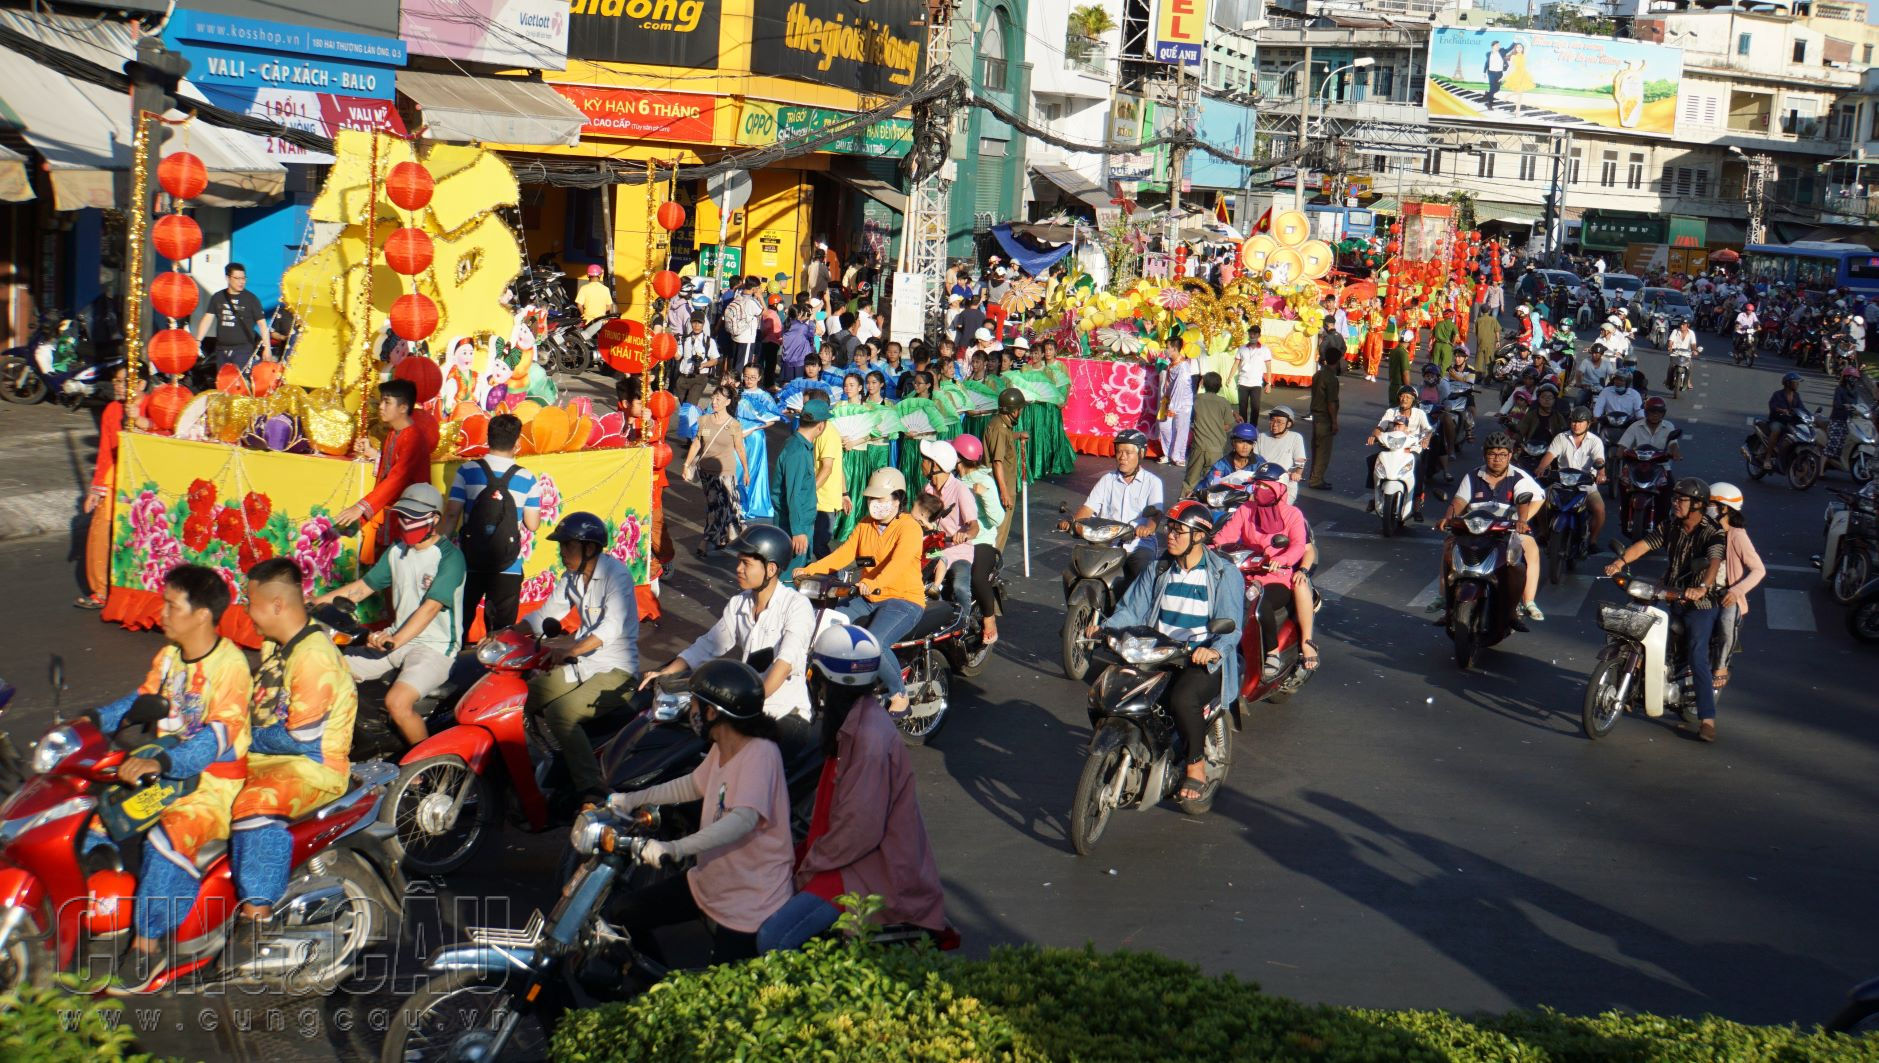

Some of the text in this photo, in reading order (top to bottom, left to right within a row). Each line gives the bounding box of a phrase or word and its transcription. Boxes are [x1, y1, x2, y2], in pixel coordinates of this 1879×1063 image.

[519, 12, 550, 29] Vietlott
[639, 22, 672, 31] .com
[196, 23, 301, 47] www.kosshop.vn
[1160, 45, 1198, 61] QUẾ ANH
[207, 57, 245, 79] VALI
[290, 62, 329, 87] XÁCH
[341, 71, 377, 93] BALO
[349, 106, 372, 122] VALI
[584, 96, 601, 112] KỲ
[605, 102, 635, 116] HẠN
[638, 99, 650, 115] 6
[653, 103, 700, 119] THÁNG
[593, 118, 612, 128] CAO
[613, 118, 631, 129] CẤP
[745, 112, 773, 136] OPPO
[267, 138, 273, 154] 2
[725, 260, 737, 269] 4G
